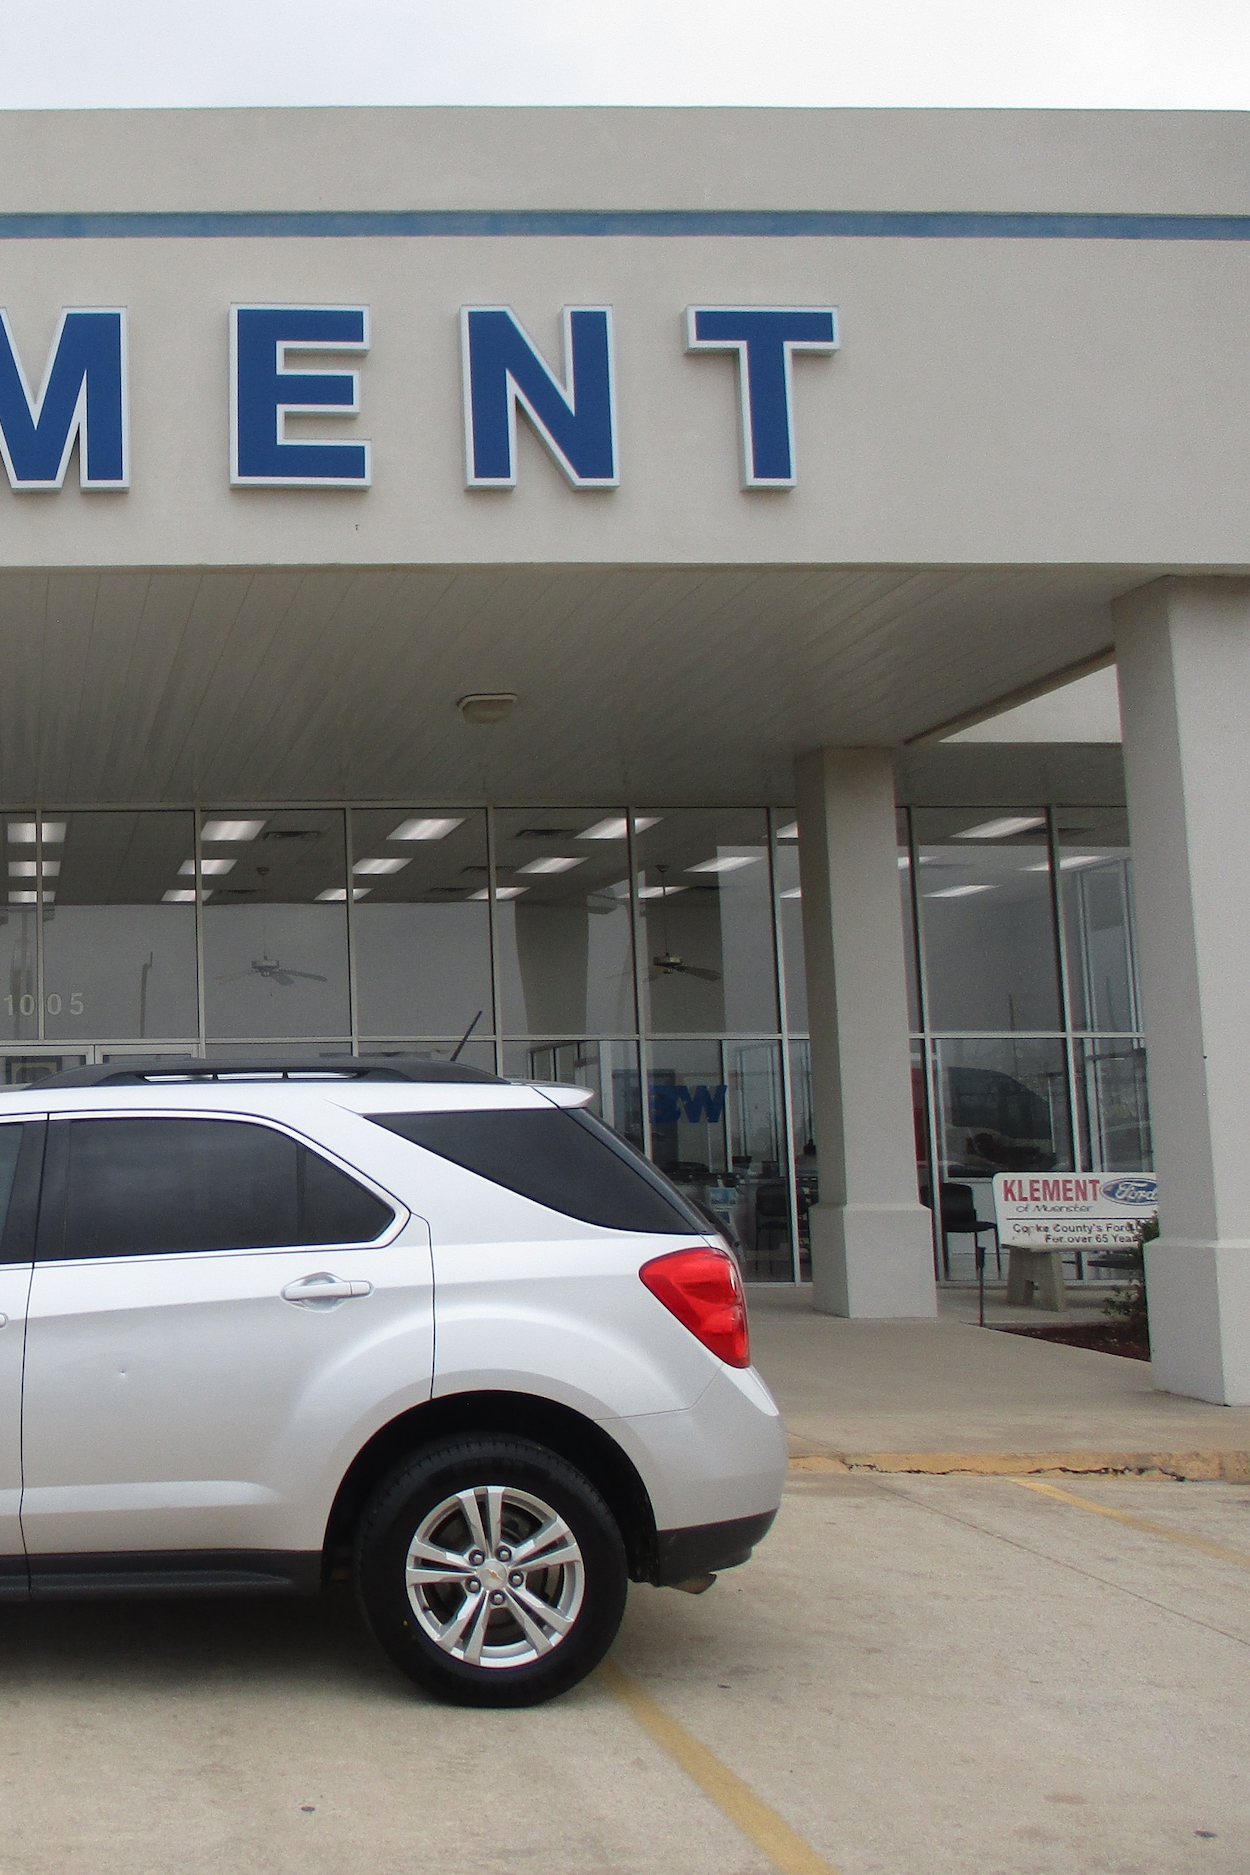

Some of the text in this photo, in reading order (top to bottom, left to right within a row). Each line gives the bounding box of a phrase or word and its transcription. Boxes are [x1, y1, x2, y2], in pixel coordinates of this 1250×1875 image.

[3, 992, 85, 1016] 1005
[1003, 1179, 1100, 1202] KLEMENT
[1015, 1203, 1093, 1213] of Muenster
[1053, 1223, 1102, 1234] County's
[1045, 1234, 1063, 1243] For
[1095, 1234, 1108, 1243] 65
